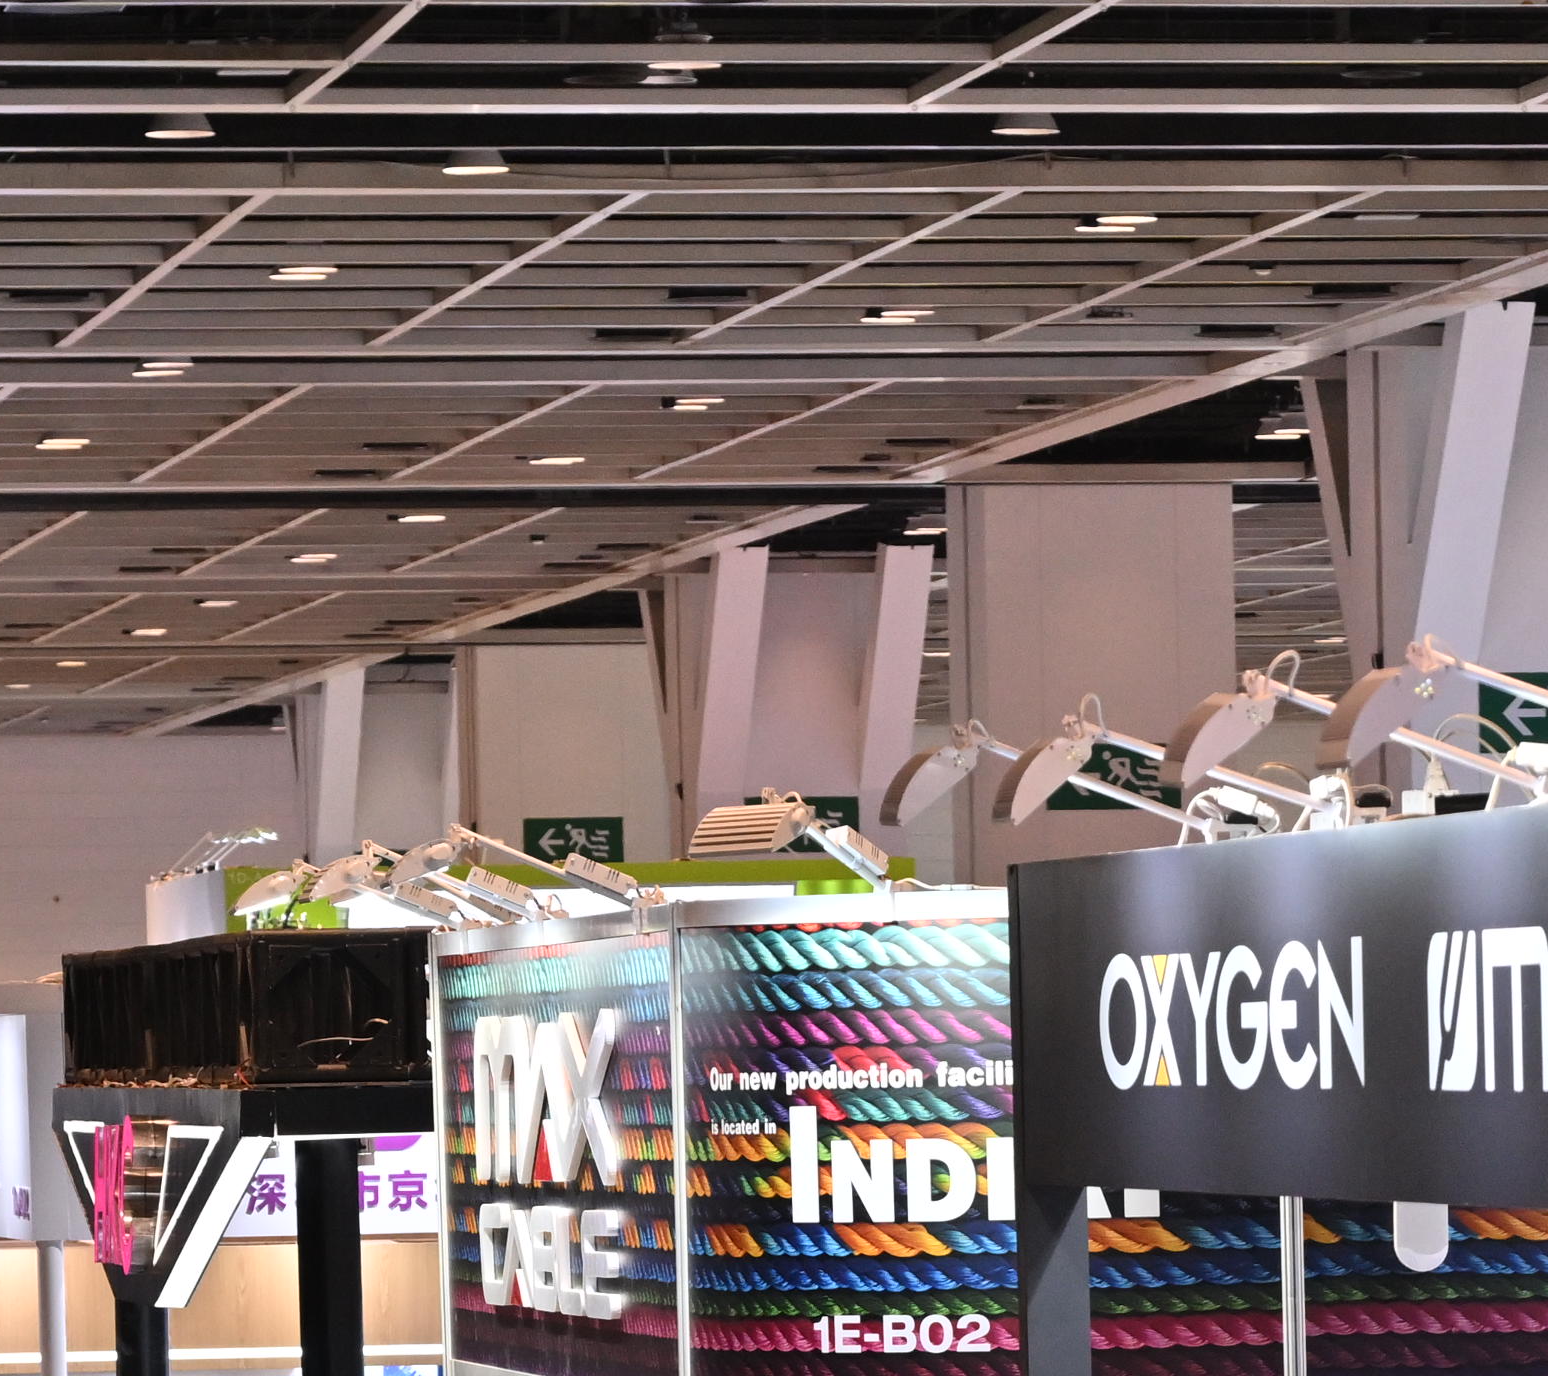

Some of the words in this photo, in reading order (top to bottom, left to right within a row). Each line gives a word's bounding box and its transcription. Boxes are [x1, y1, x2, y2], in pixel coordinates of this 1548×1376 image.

[1100, 935, 1367, 1092] OXYGEN
[473, 1008, 622, 1187] MAX
[709, 1067, 733, 1092] Our
[739, 1071, 776, 1092] new
[785, 1063, 924, 1096] production
[936, 1060, 1014, 1089] facili
[710, 1119, 718, 1135] is
[721, 1119, 759, 1135] located
[763, 1119, 777, 1135] in
[789, 1106, 1016, 1224] INDI
[478, 1201, 623, 1321] CABLE
[812, 1313, 992, 1355] 1E-B02
